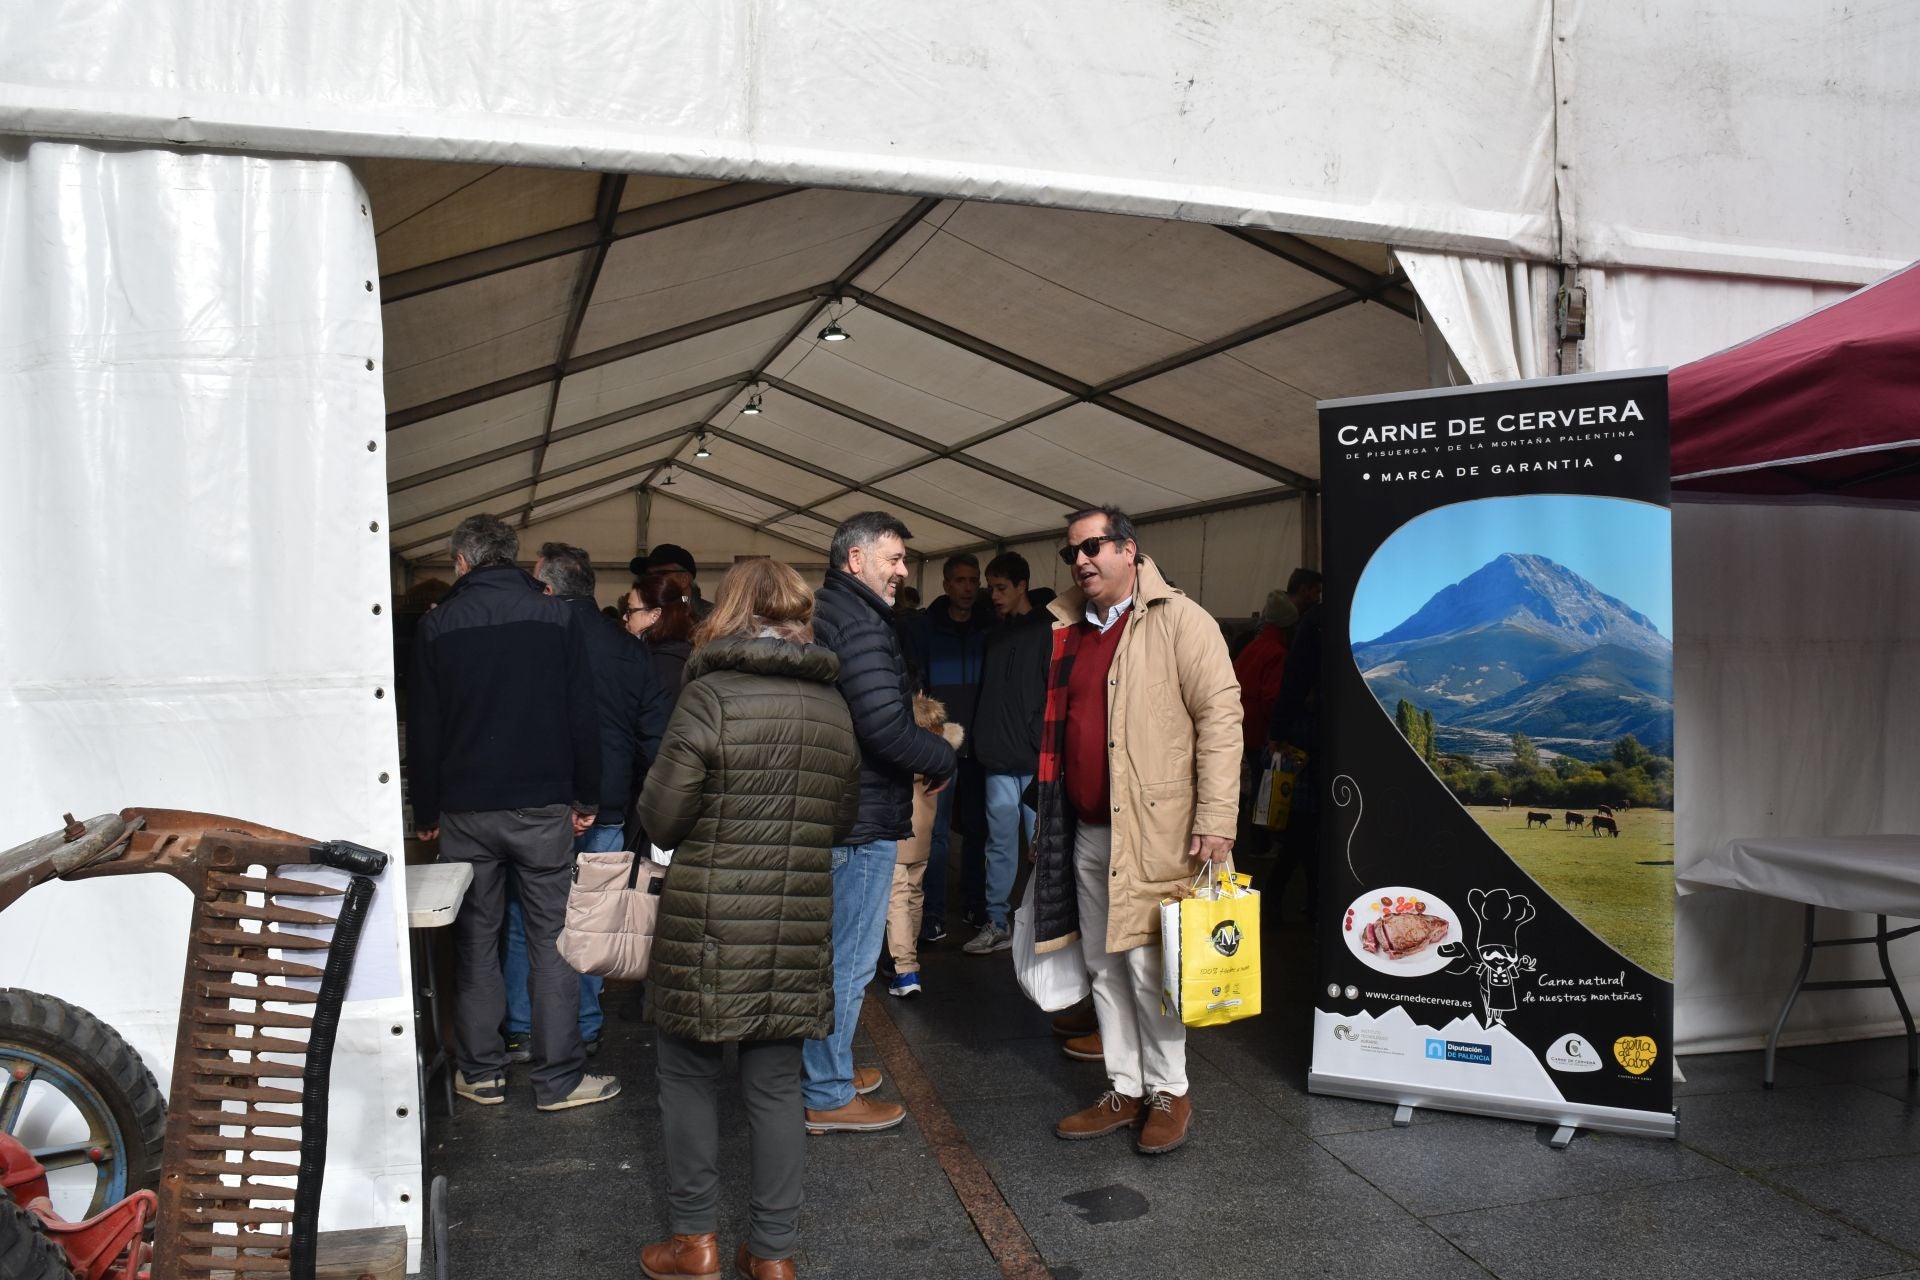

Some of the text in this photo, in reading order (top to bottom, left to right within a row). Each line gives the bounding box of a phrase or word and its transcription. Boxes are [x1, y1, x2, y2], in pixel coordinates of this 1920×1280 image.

[1337, 399, 1645, 446] CARNE DE CERVERA
[1367, 447, 1427, 458] PISUERGA
[1491, 437, 1552, 448] MONTAÑA
[1559, 430, 1636, 443] PALENTINA
[1381, 458, 1594, 482] MARCA DE GARANTIA
[1538, 970, 1625, 987] Carne natural
[1365, 990, 1473, 1008] www.carnedecervera.es
[1522, 991, 1643, 1003] de nuestras montañas
[1447, 1043, 1483, 1054] Diputación
[1458, 1052, 1490, 1062] PALENCIA
